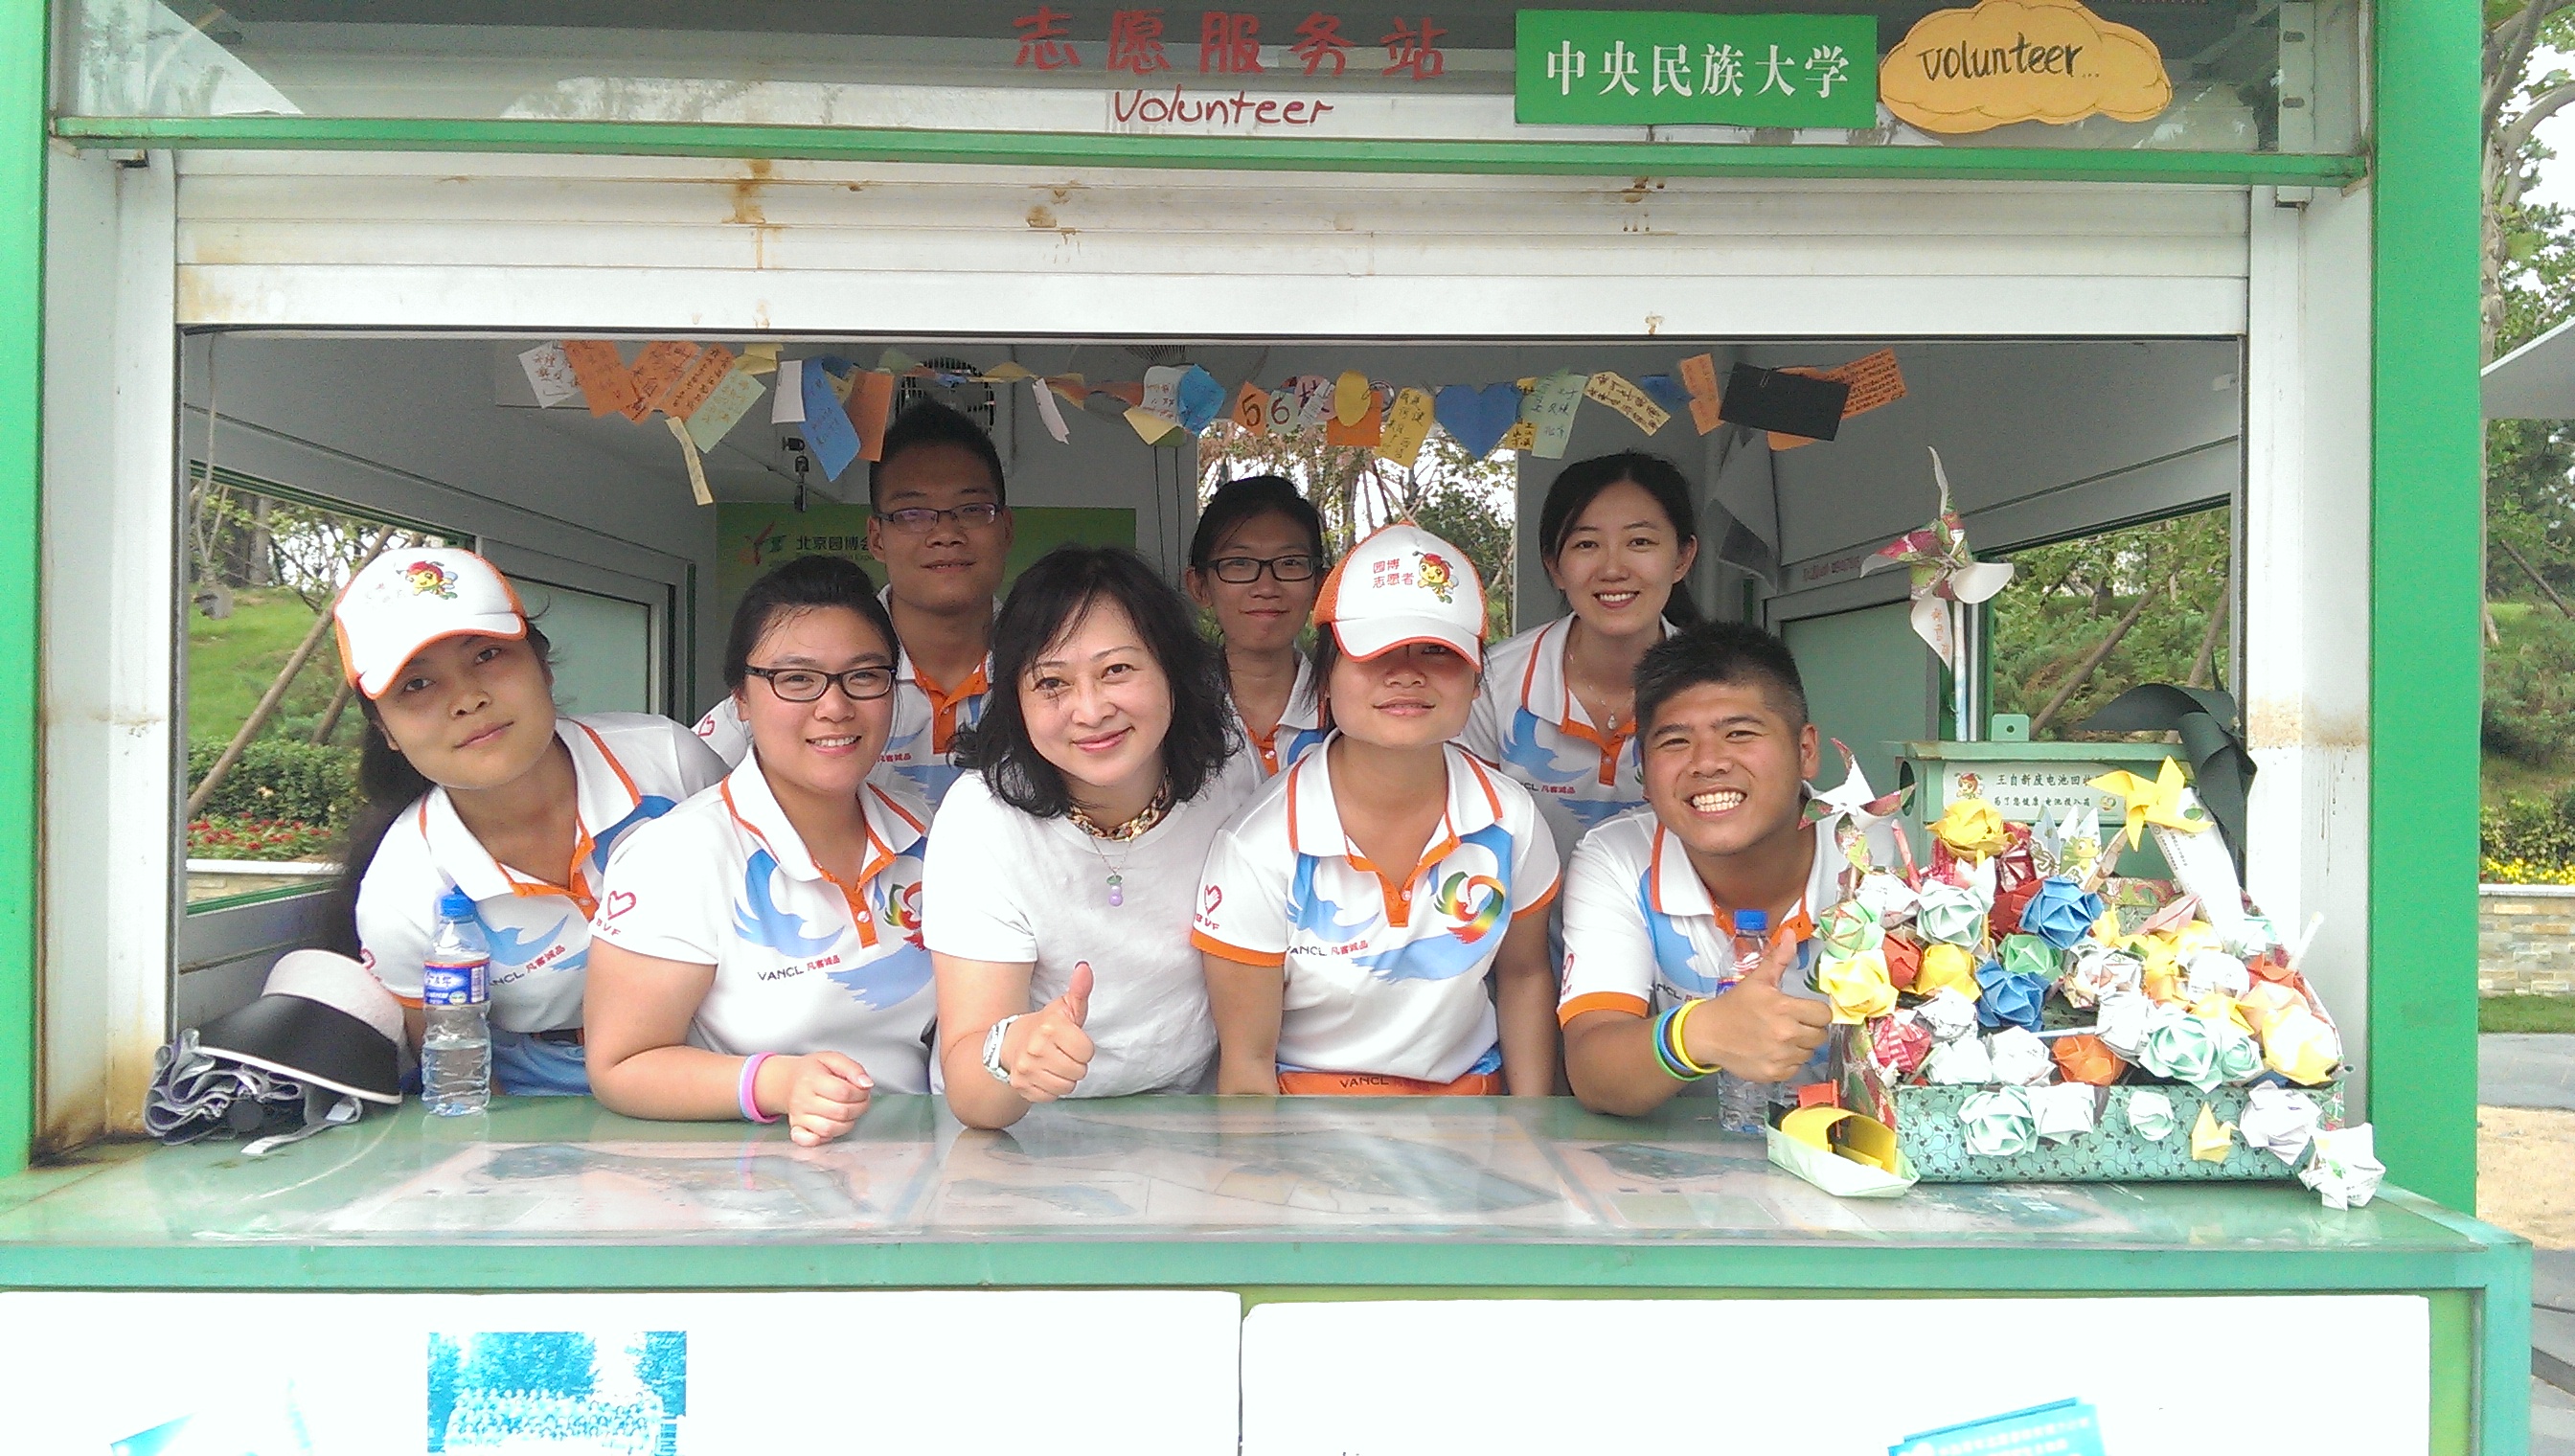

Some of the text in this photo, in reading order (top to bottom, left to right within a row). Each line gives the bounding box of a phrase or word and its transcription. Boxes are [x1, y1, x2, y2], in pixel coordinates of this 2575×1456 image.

[1012, 6, 1447, 80] 志愿服务站
[1545, 40, 1851, 99] 中央民族大学
[1373, 572, 1415, 589] 志愿者
[757, 966, 805, 981] VANCL
[1339, 1077, 1390, 1088] VANCL
